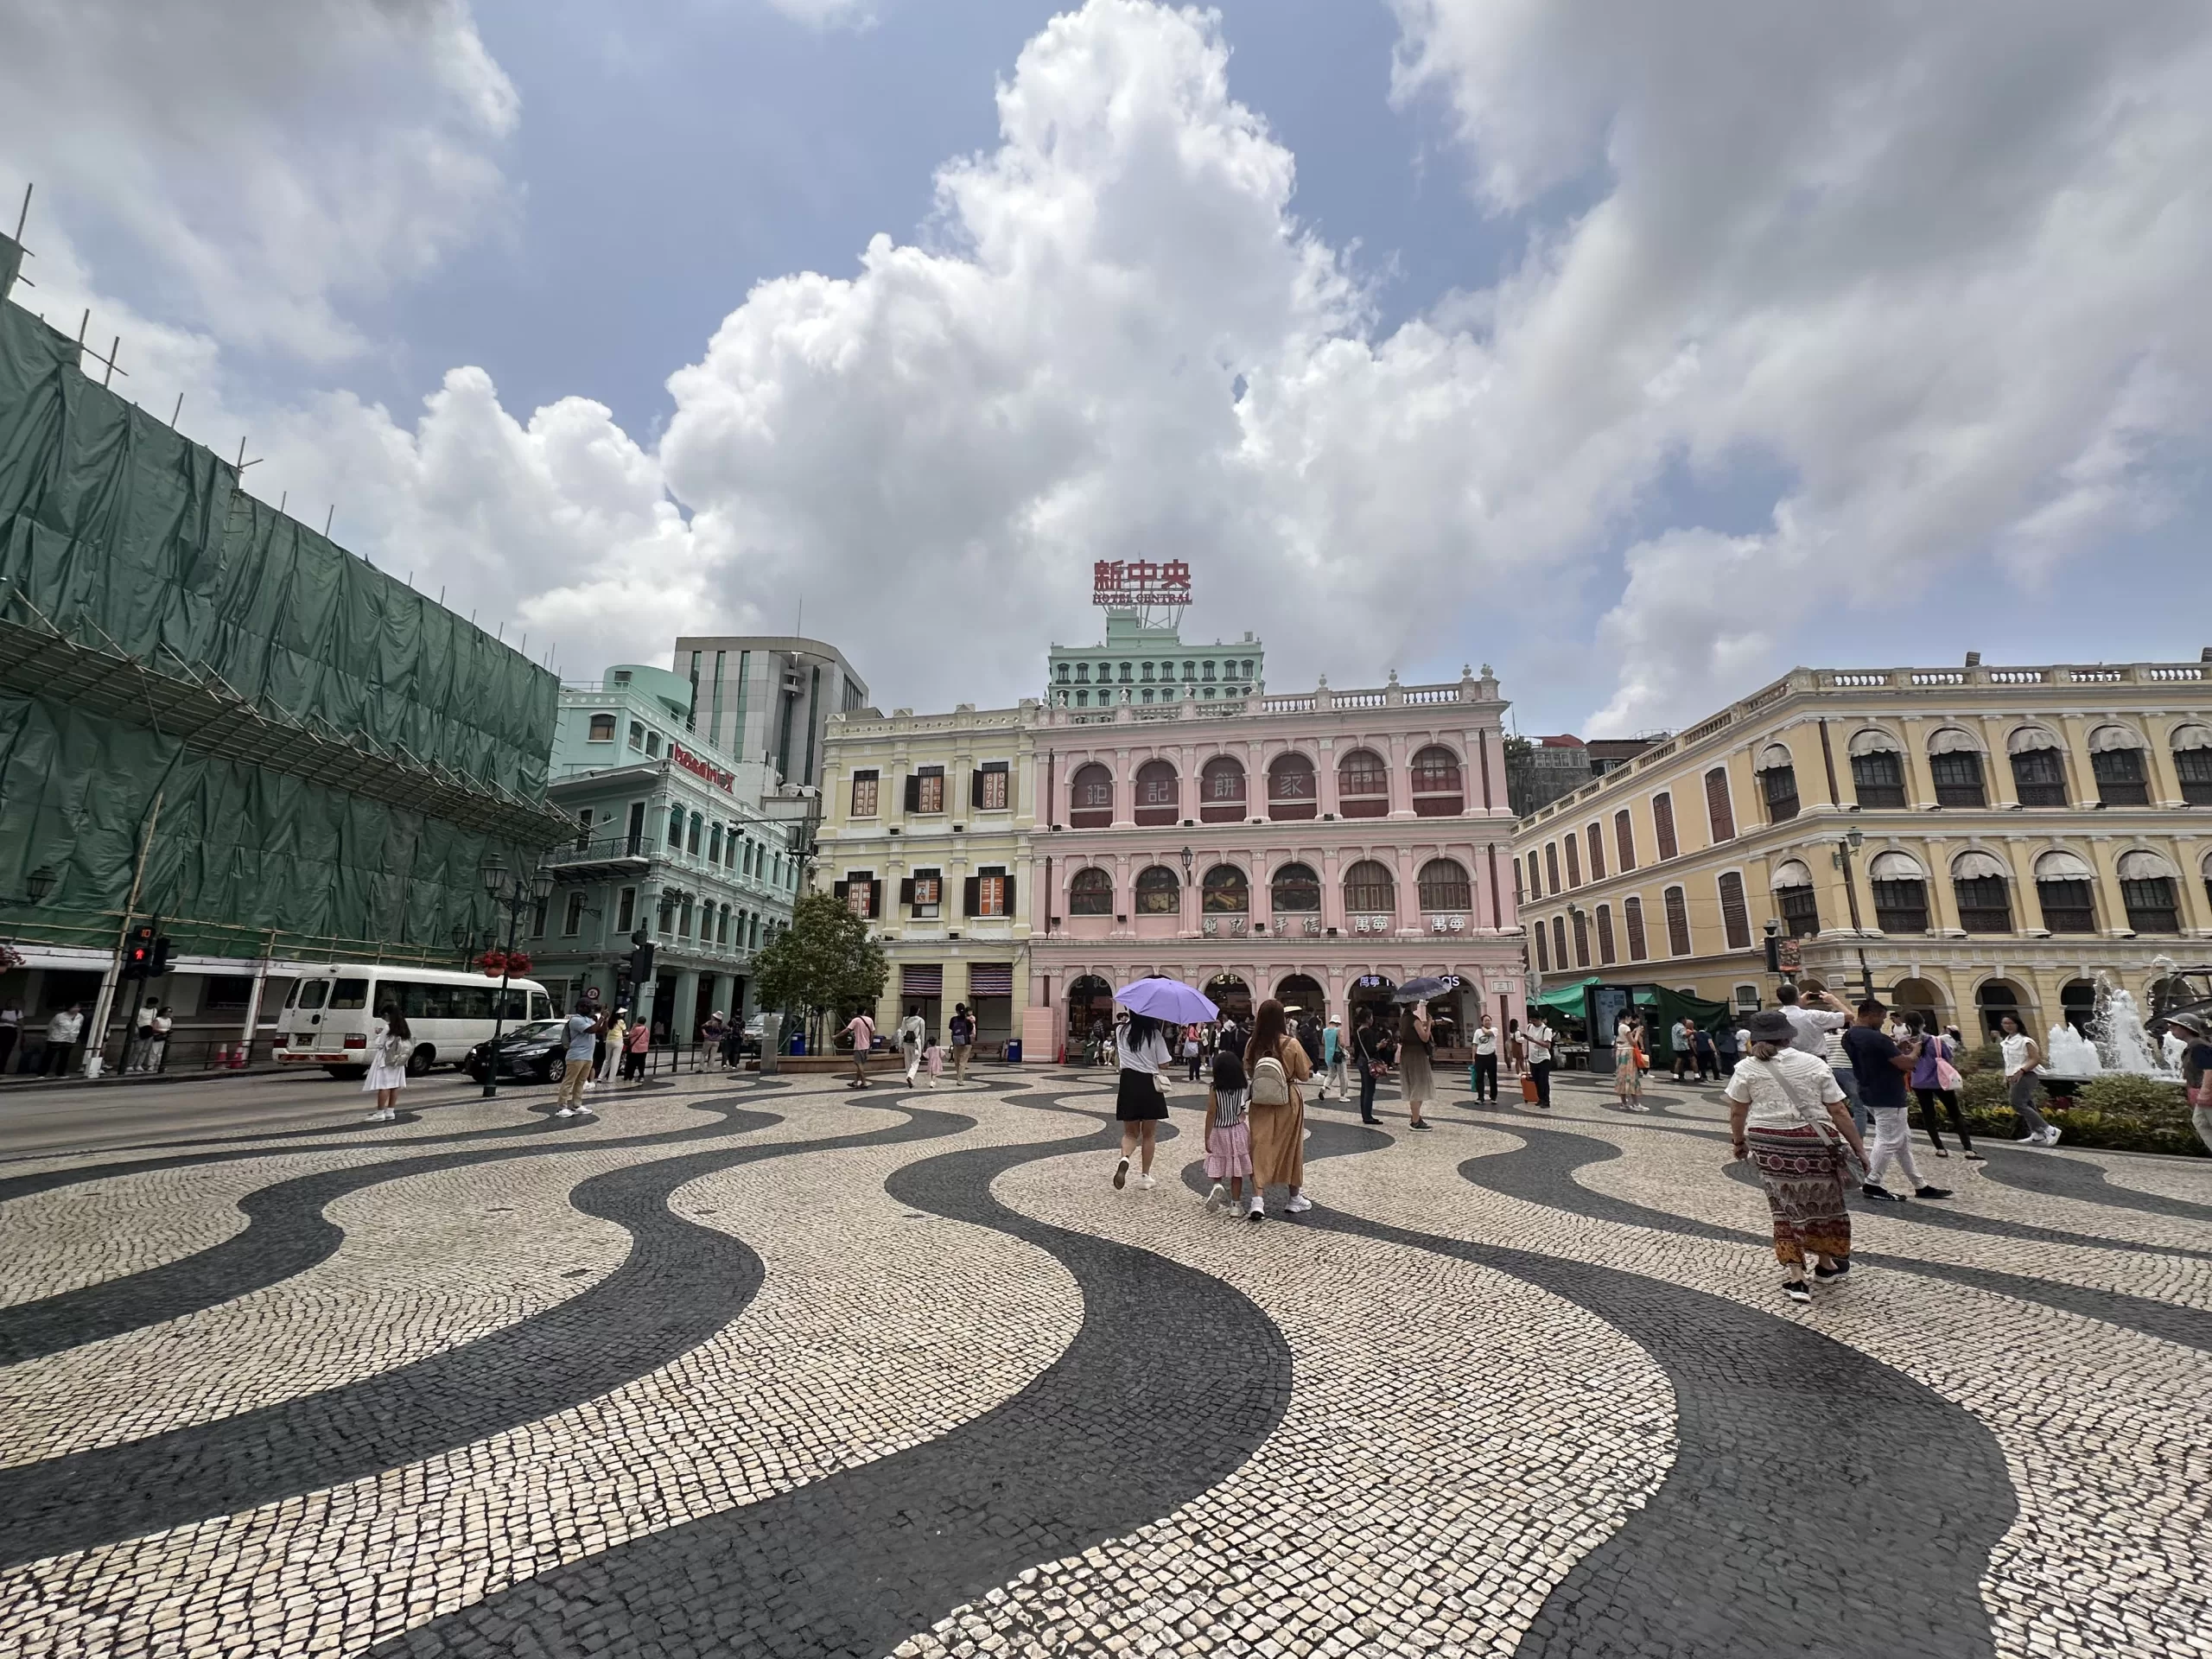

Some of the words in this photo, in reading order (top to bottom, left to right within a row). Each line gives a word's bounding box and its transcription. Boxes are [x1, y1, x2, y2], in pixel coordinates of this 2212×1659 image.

[1094, 559, 1191, 590] 新中央
[1093, 594, 1132, 604] HOTEL
[1135, 594, 1192, 604] CENTRAL
[1274, 917, 1319, 933] 手信
[1355, 915, 1388, 932] 萬寧
[1431, 914, 1465, 932] 萬寧
[141, 929, 151, 938] 10
[1359, 976, 1380, 987] 萬寧
